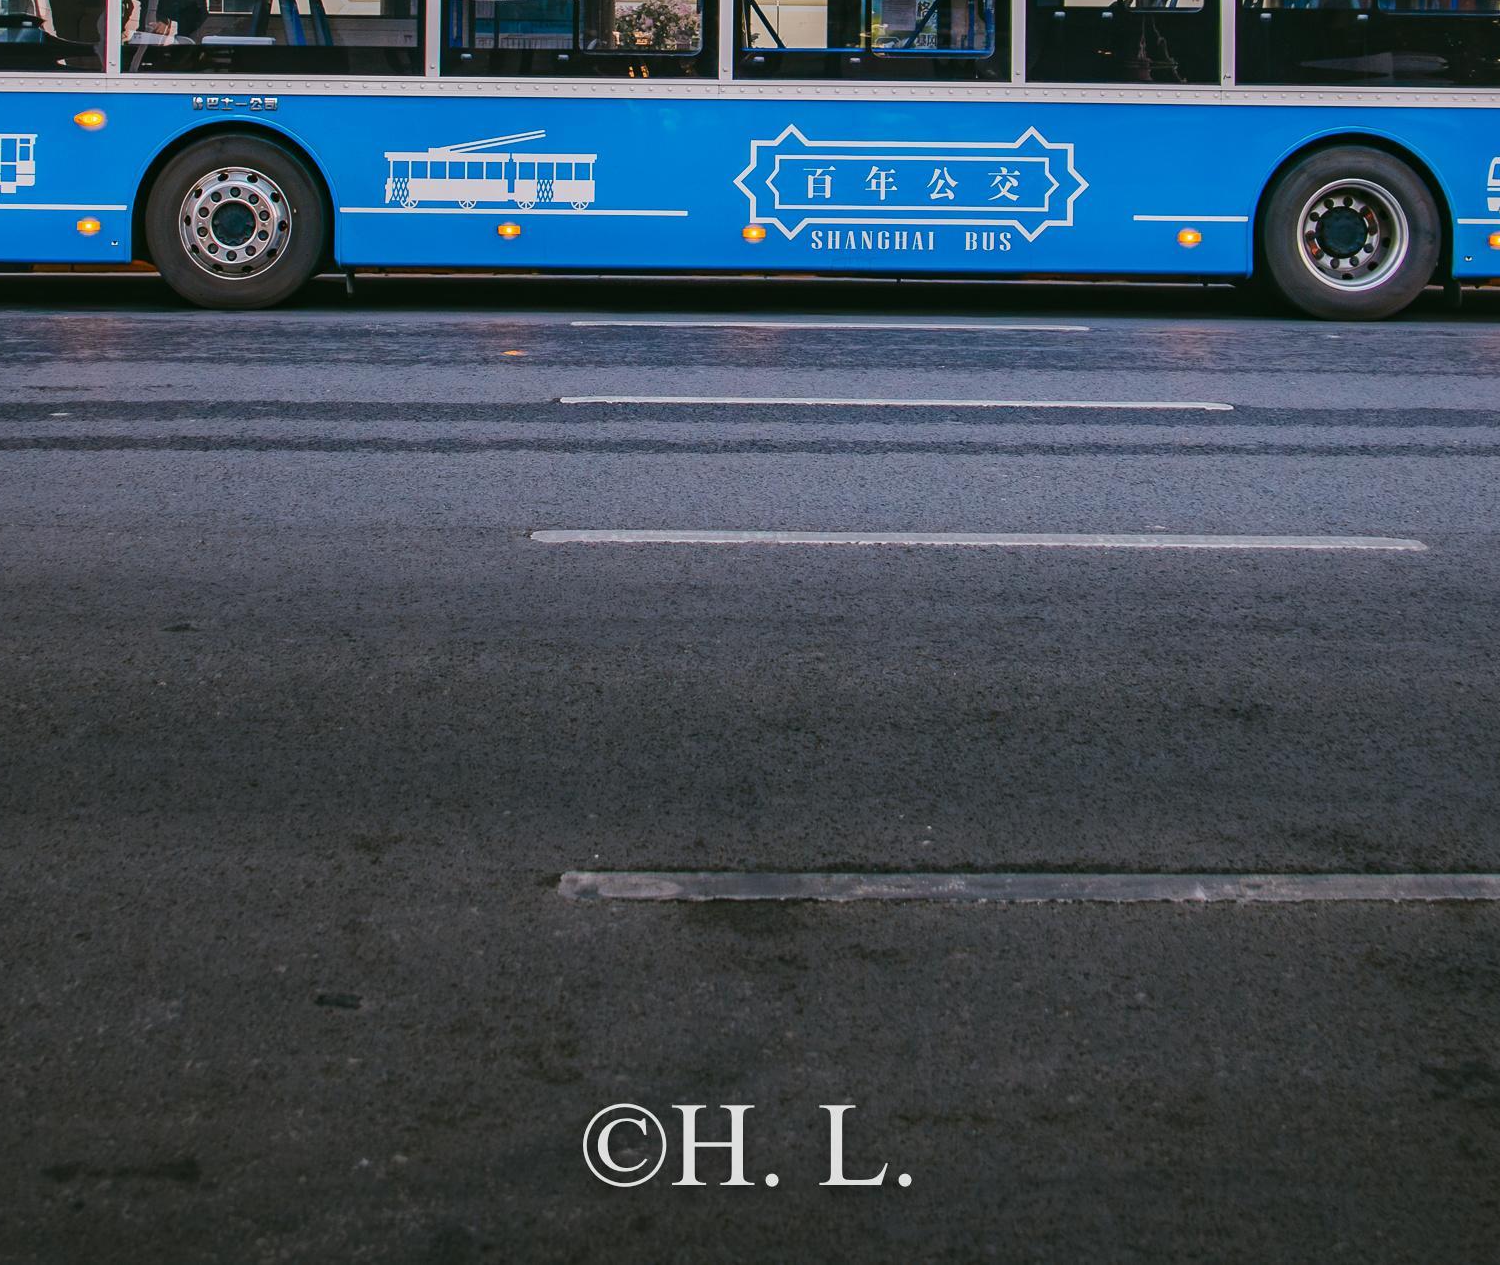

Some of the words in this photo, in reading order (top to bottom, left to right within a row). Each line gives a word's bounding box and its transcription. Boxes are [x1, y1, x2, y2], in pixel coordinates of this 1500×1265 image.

[803, 165, 1021, 202] 百年公交
[810, 230, 937, 251] SHANGHAI
[964, 231, 1013, 252] BUS
